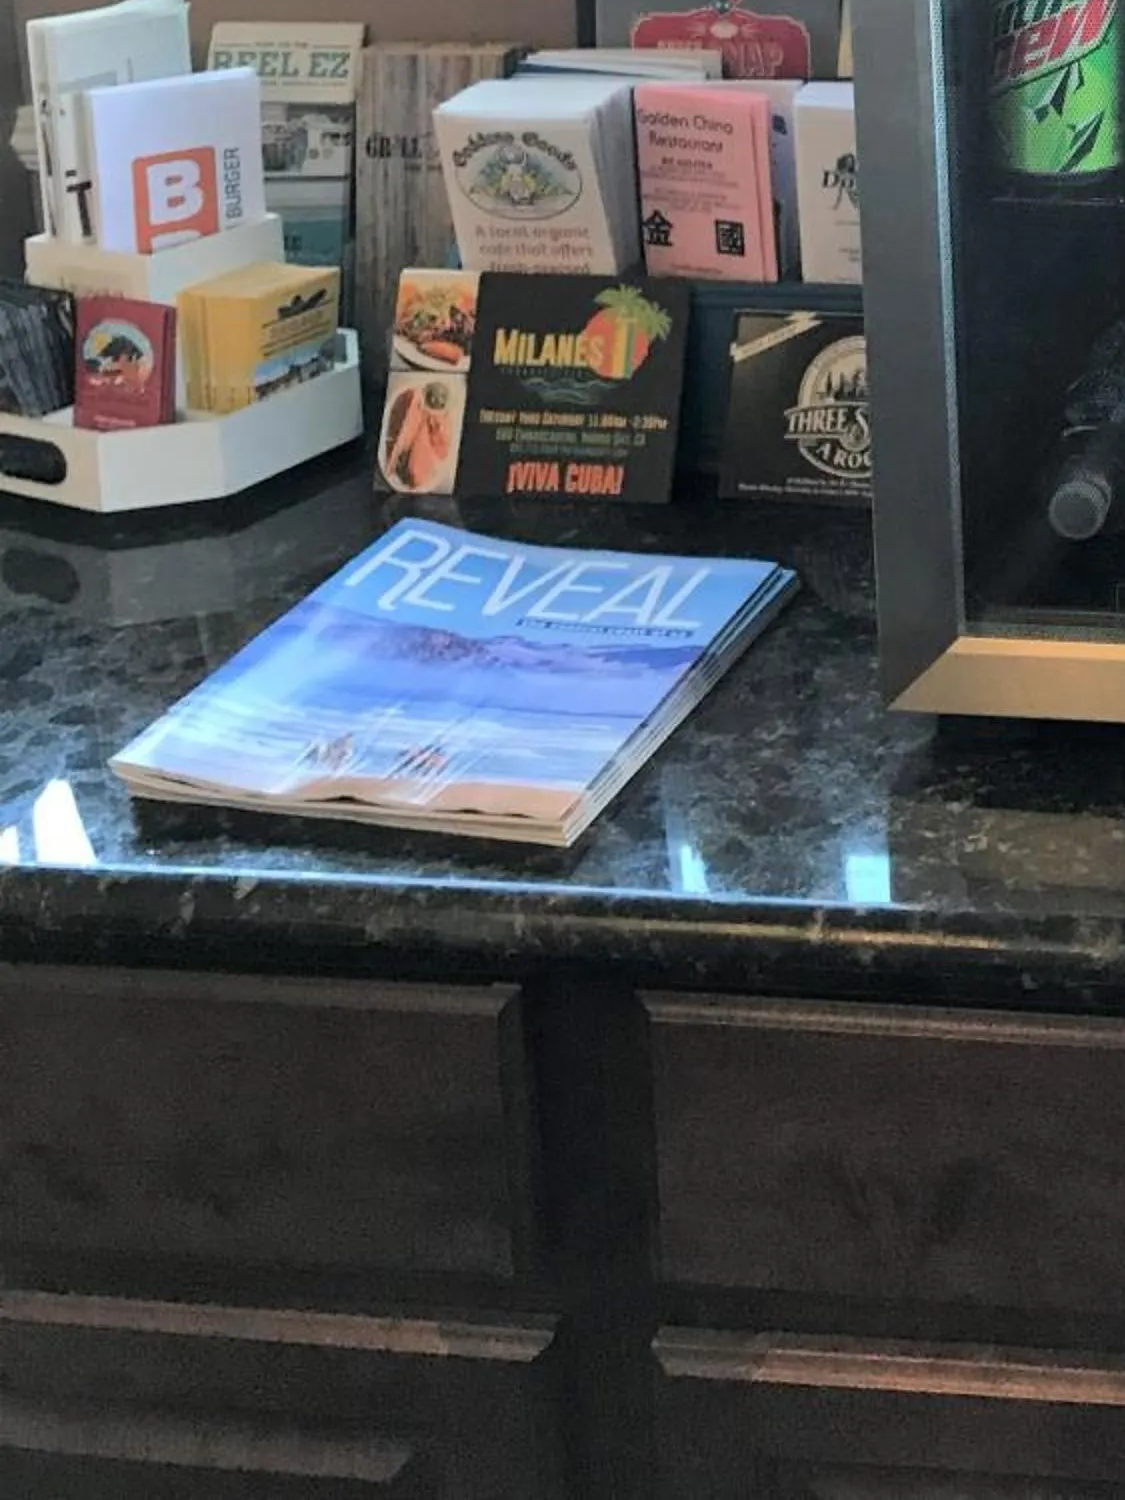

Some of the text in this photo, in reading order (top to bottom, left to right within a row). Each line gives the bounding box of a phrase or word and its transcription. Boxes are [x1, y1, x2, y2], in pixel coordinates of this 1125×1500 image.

[308, 51, 351, 78] EZ
[694, 115, 733, 135] China
[224, 147, 243, 219] BURGER
[788, 408, 849, 432] THREE
[565, 464, 625, 495] CUBA!
[344, 529, 712, 628] REVEAL
